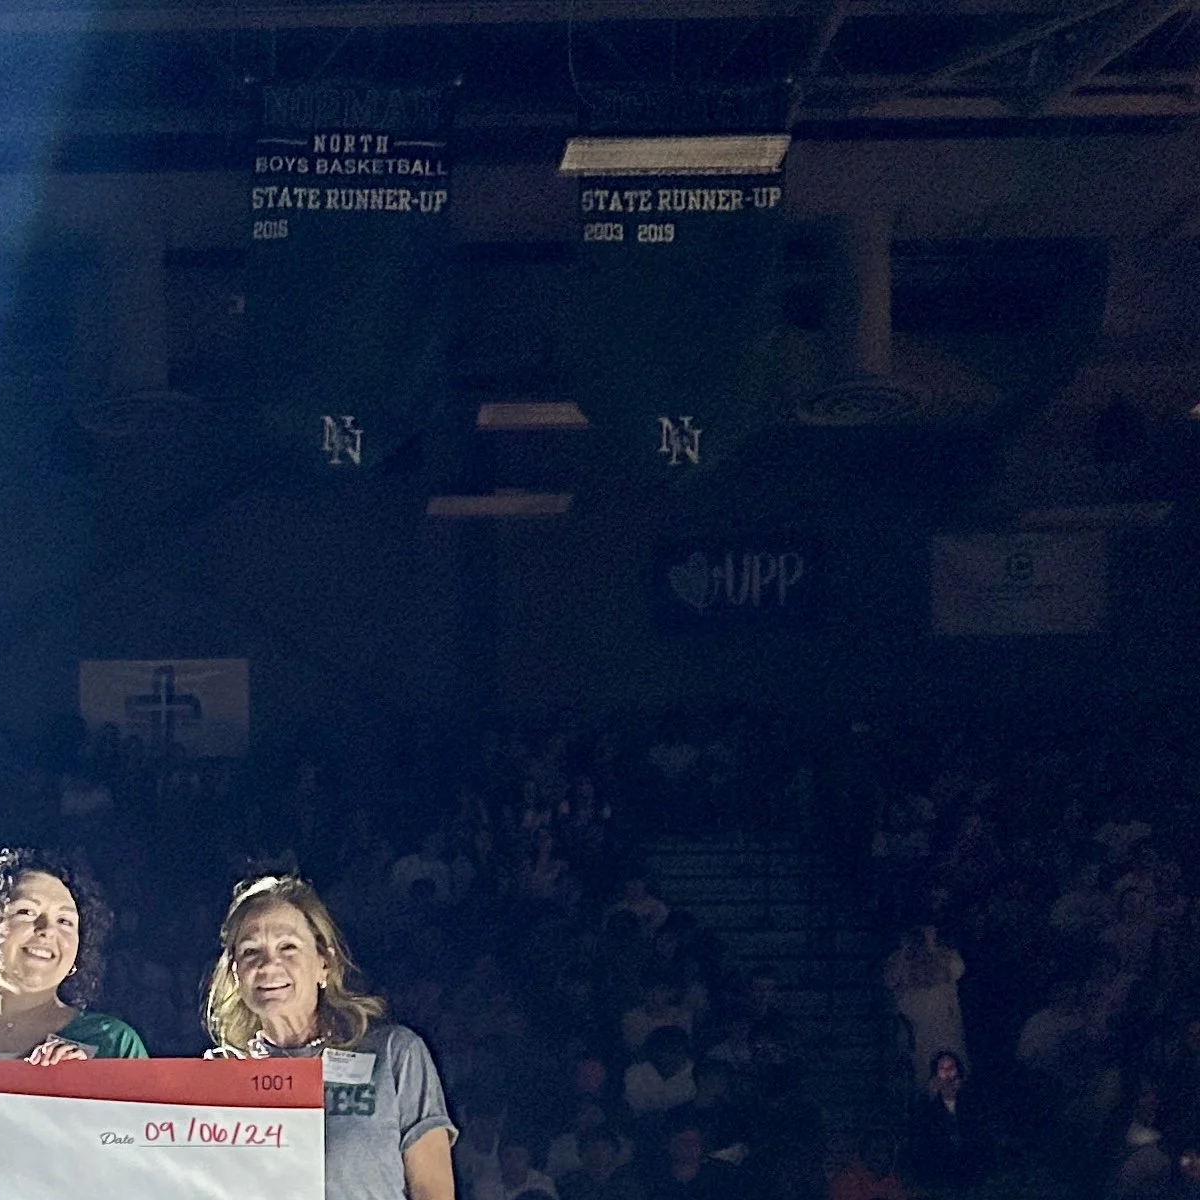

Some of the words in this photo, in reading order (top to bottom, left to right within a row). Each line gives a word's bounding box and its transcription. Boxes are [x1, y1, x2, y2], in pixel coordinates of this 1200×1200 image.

[313, 134, 389, 154] NORTH
[255, 156, 309, 173] BOYS
[316, 157, 449, 176] BASKETBALL
[252, 185, 321, 210] STATE
[326, 188, 448, 213] RUNNER-UP
[581, 189, 652, 212] STATE
[657, 187, 782, 212] RUNNER-UP
[638, 223, 675, 242] 2019
[251, 1075, 294, 1090] 1001
[325, 1084, 376, 1116] ES
[99, 1131, 135, 1146] Date
[144, 1117, 283, 1148] 09/06/24
